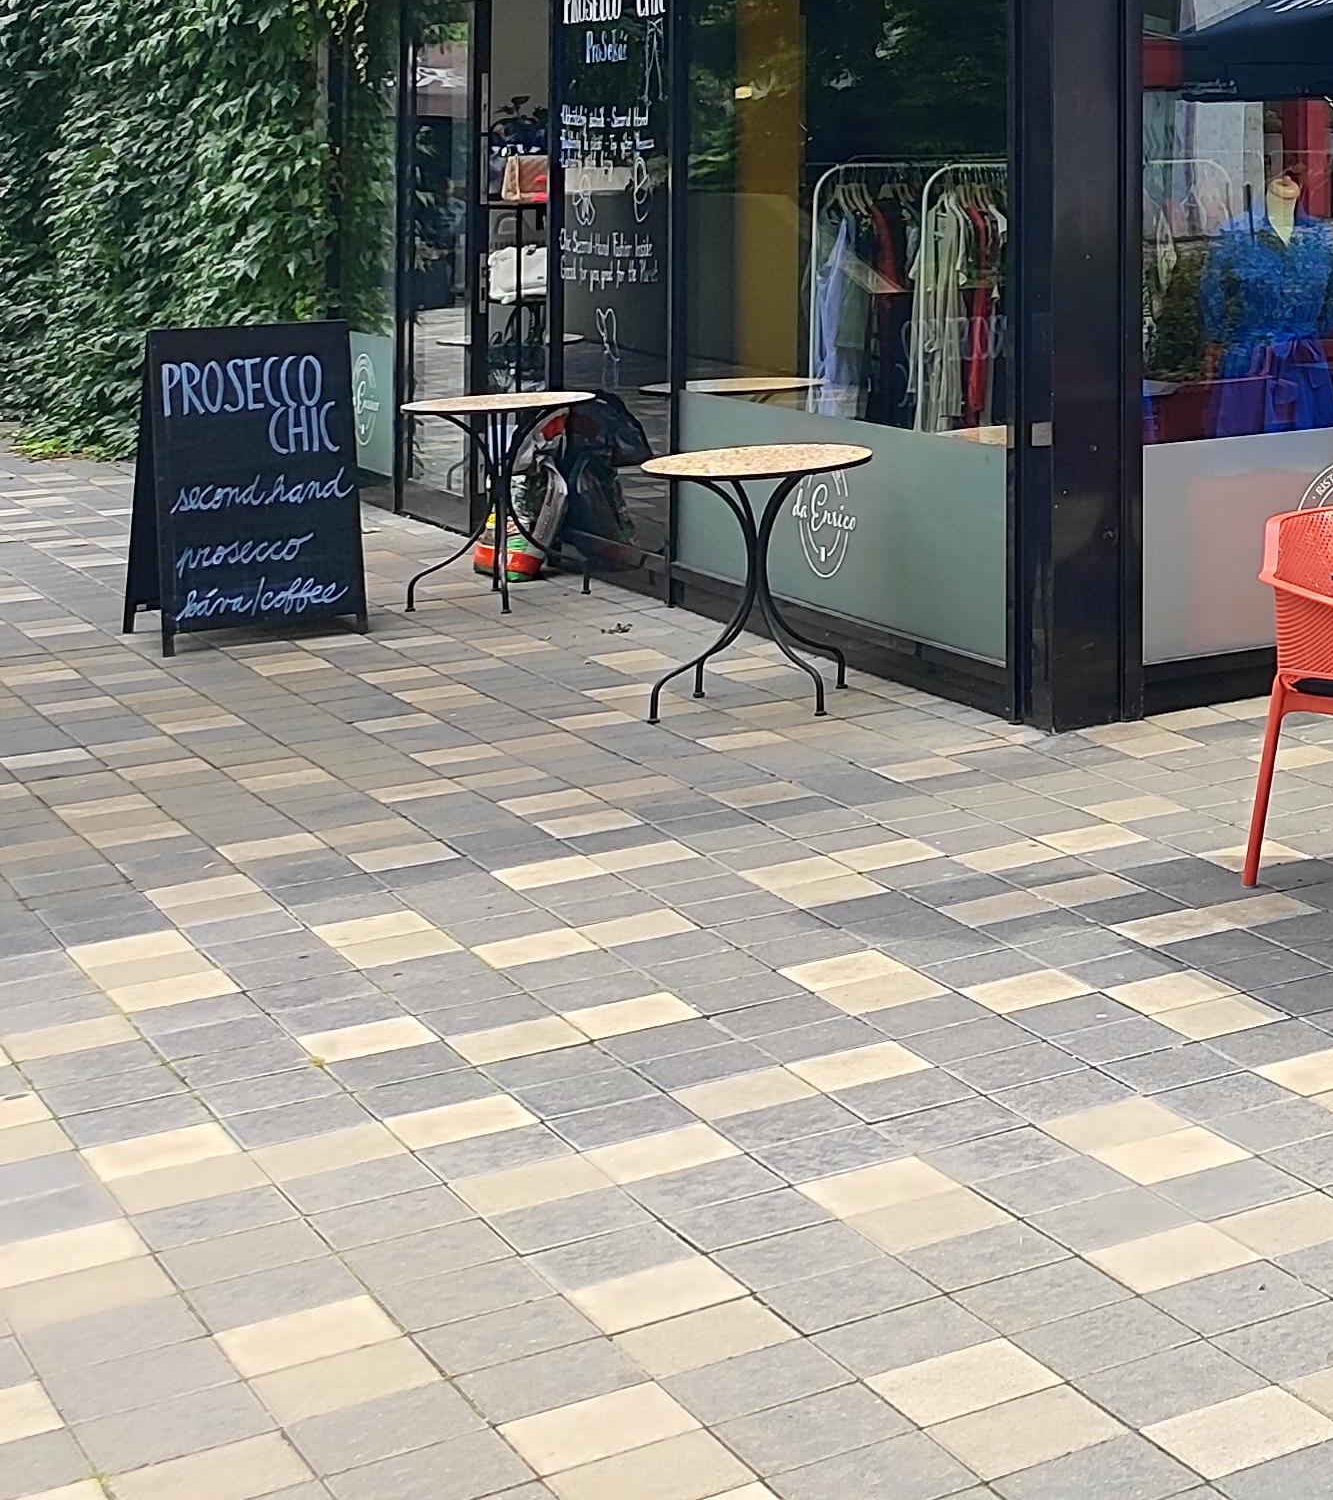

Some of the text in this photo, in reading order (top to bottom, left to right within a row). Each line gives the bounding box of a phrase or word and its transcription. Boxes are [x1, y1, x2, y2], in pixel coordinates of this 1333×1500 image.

[161, 354, 323, 417] PROSECCO
[268, 401, 341, 454] CHIC
[170, 466, 355, 514] second hand
[810, 483, 857, 532] Enrico
[176, 531, 314, 580] prosecco
